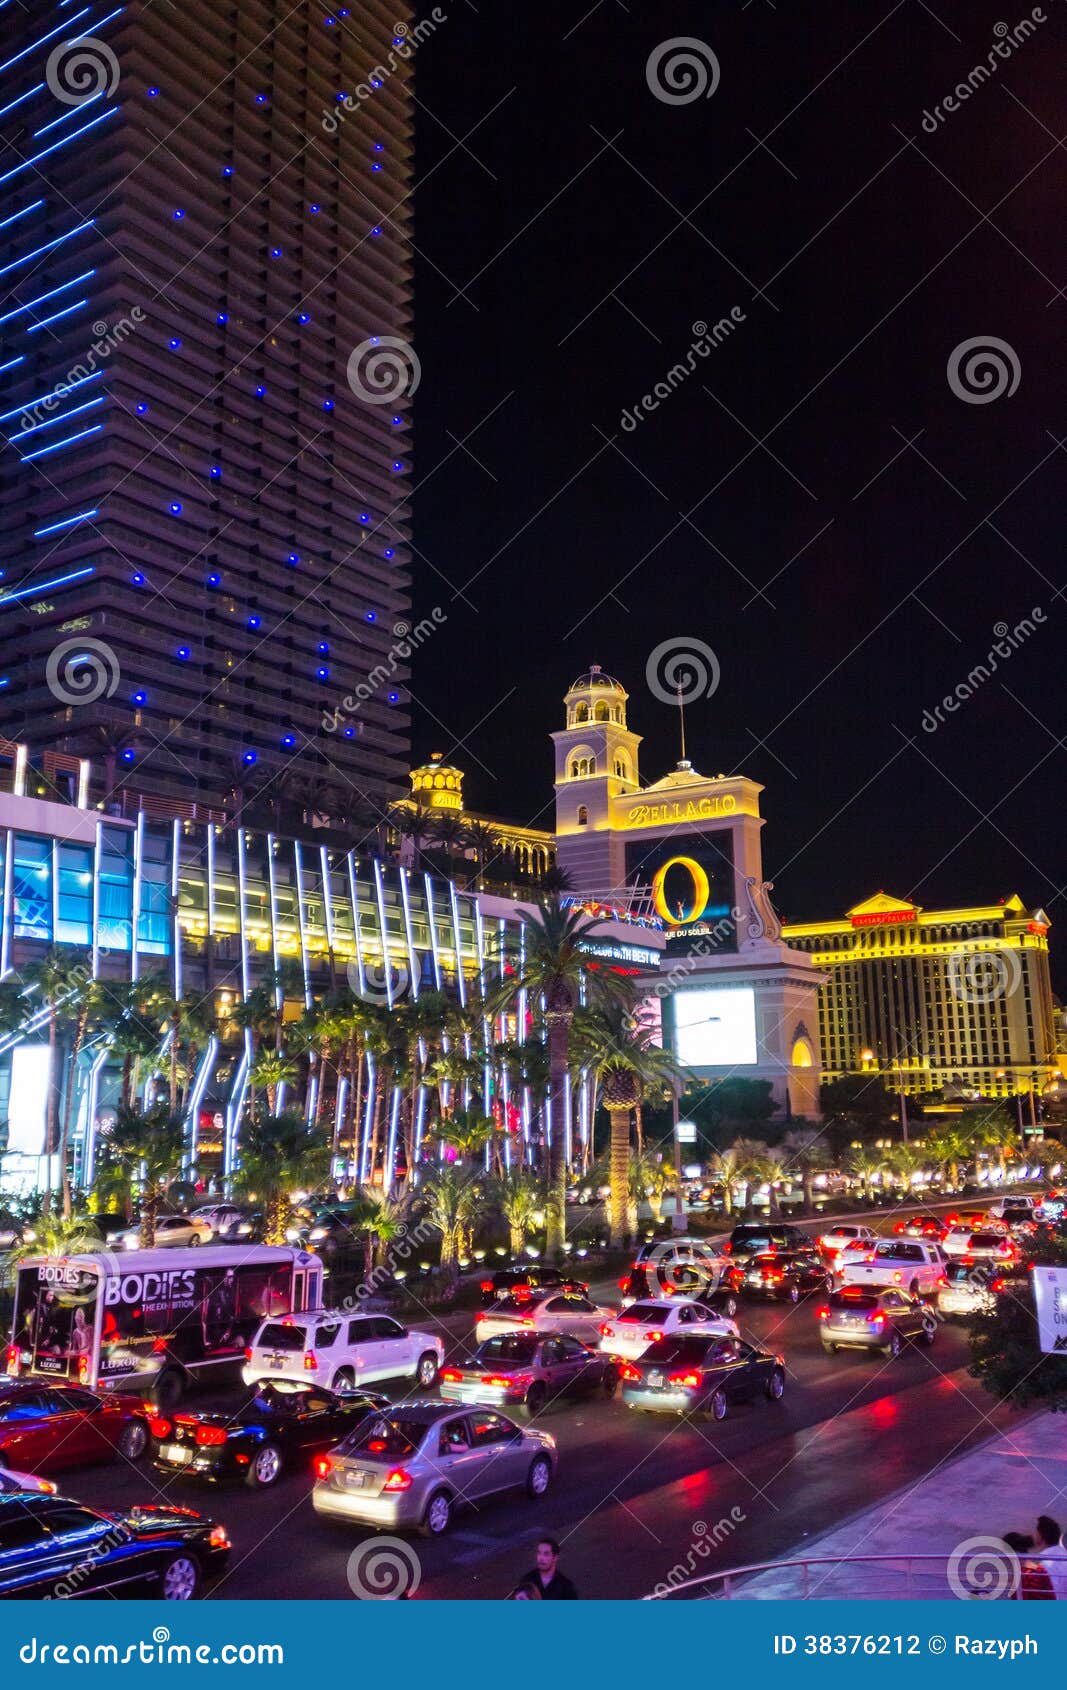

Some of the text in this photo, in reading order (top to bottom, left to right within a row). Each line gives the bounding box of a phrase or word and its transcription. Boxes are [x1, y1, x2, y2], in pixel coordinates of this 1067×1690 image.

[628, 795, 736, 825] BELLAGIO
[652, 855, 710, 925] O
[677, 929, 687, 938] DU
[632, 949, 649, 964] BEST
[38, 1267, 80, 1283] BODIES
[105, 1270, 196, 1306] BODIES
[142, 1303, 155, 1312] THE
